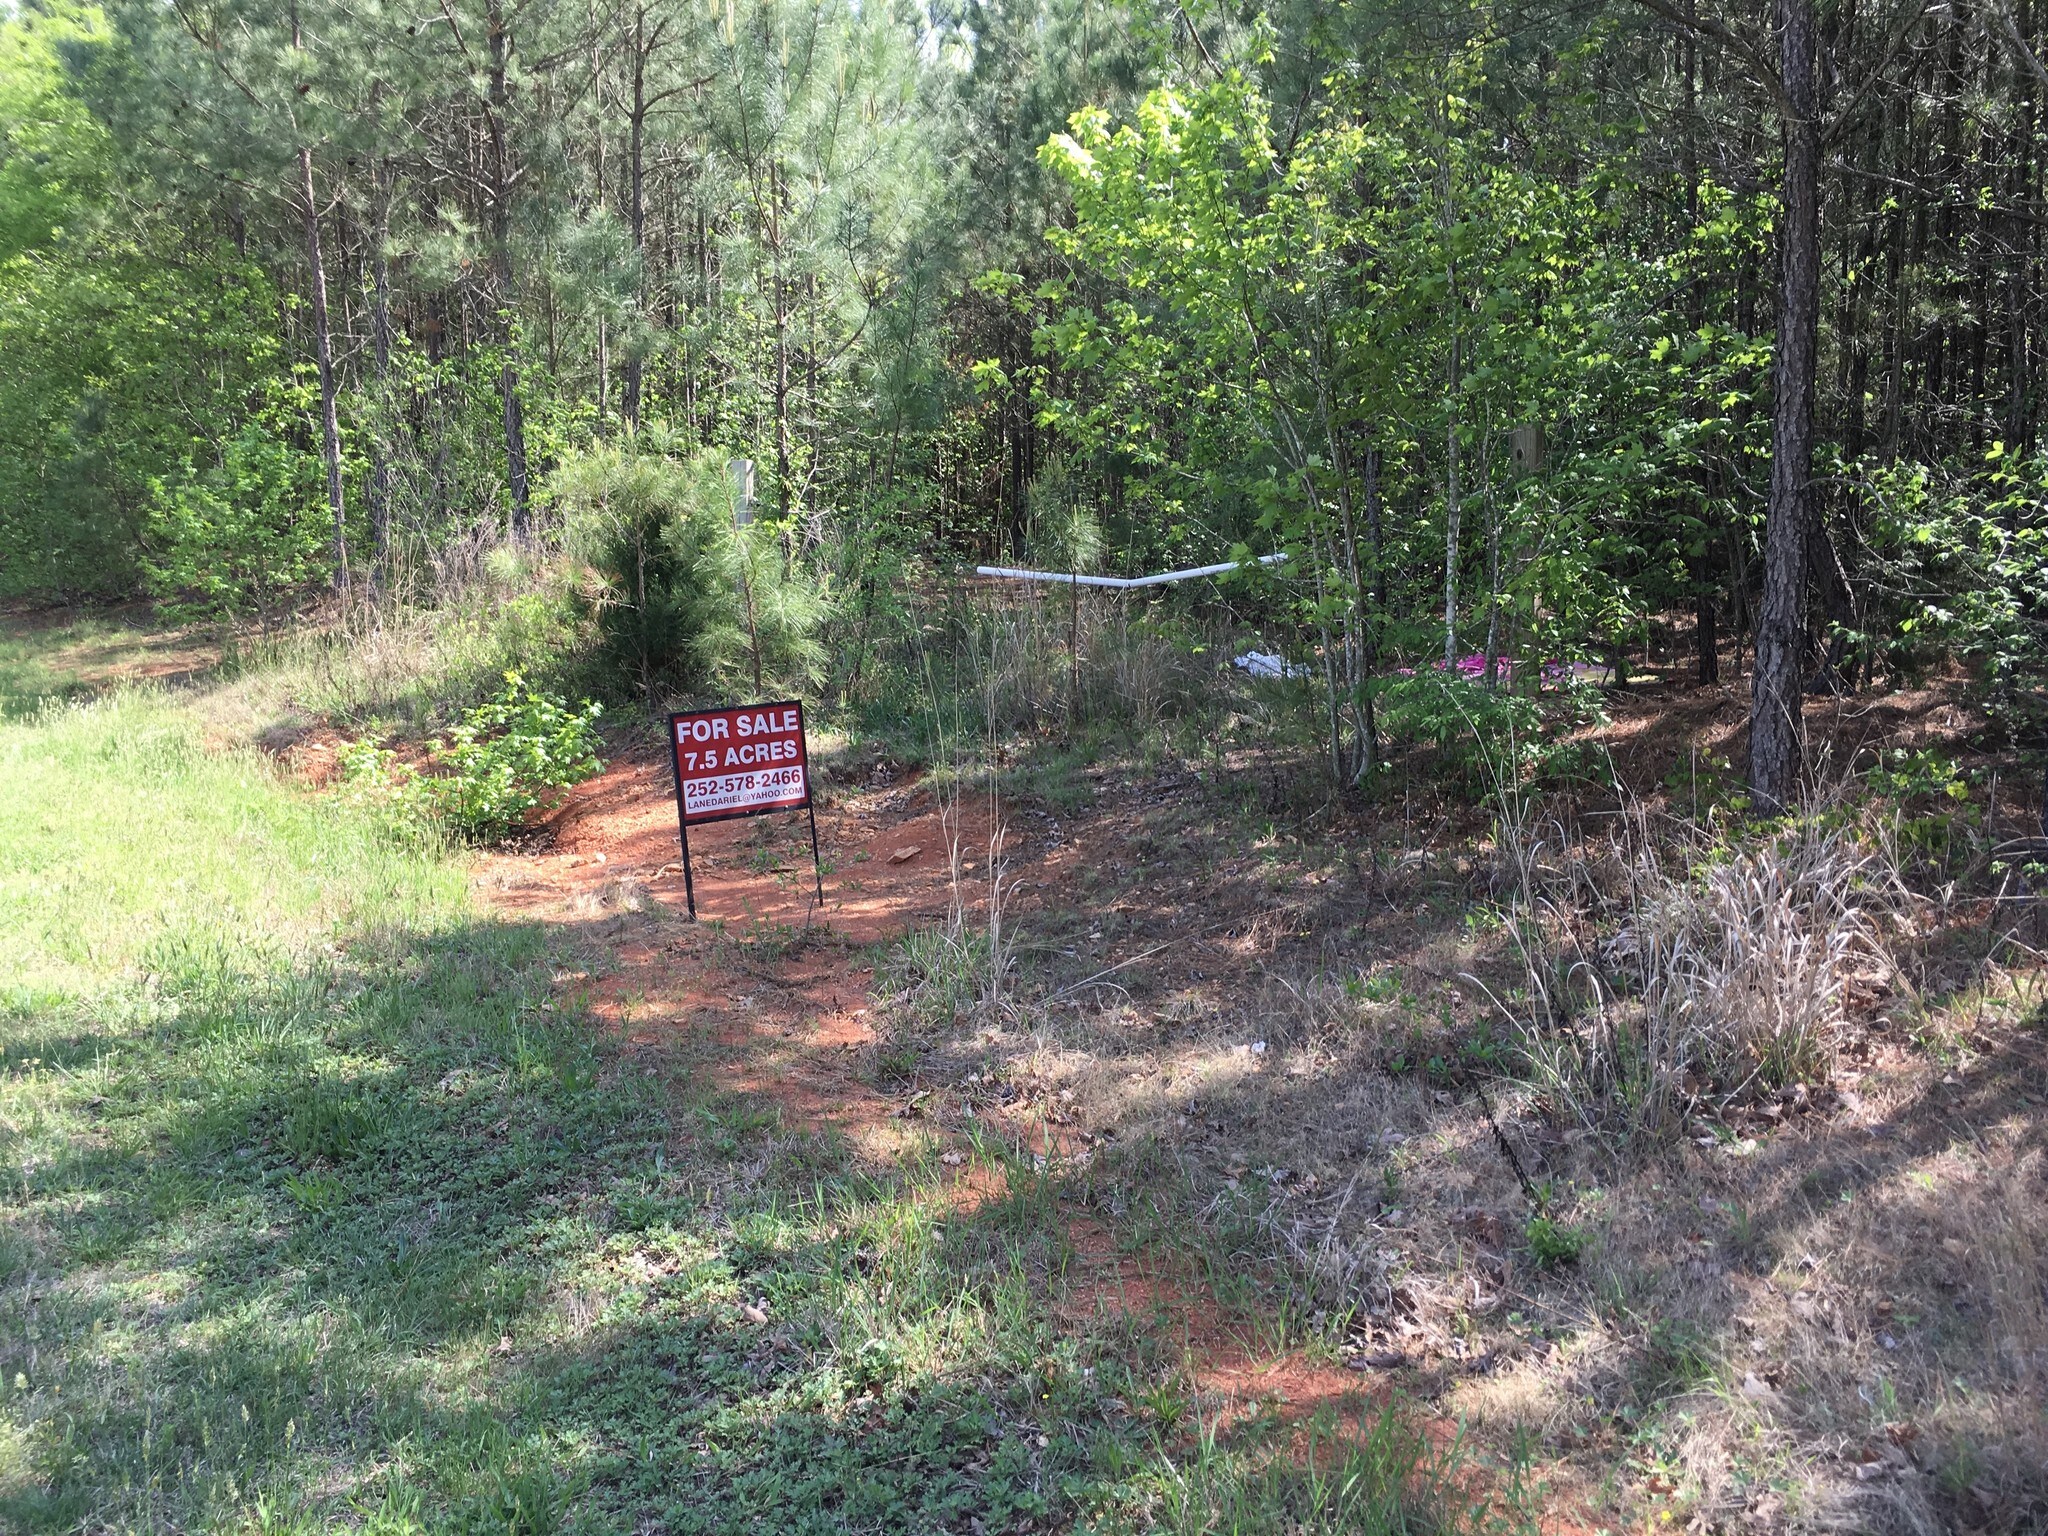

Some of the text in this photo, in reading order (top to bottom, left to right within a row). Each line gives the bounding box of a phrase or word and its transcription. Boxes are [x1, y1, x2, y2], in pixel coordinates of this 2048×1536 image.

[676, 710, 799, 744] FOR SALE
[684, 739, 798, 771] 7.5 ACRES
[686, 769, 801, 798] 252-578-2466
[688, 787, 803, 810] LANEDARIEL@YAHOO.COM
